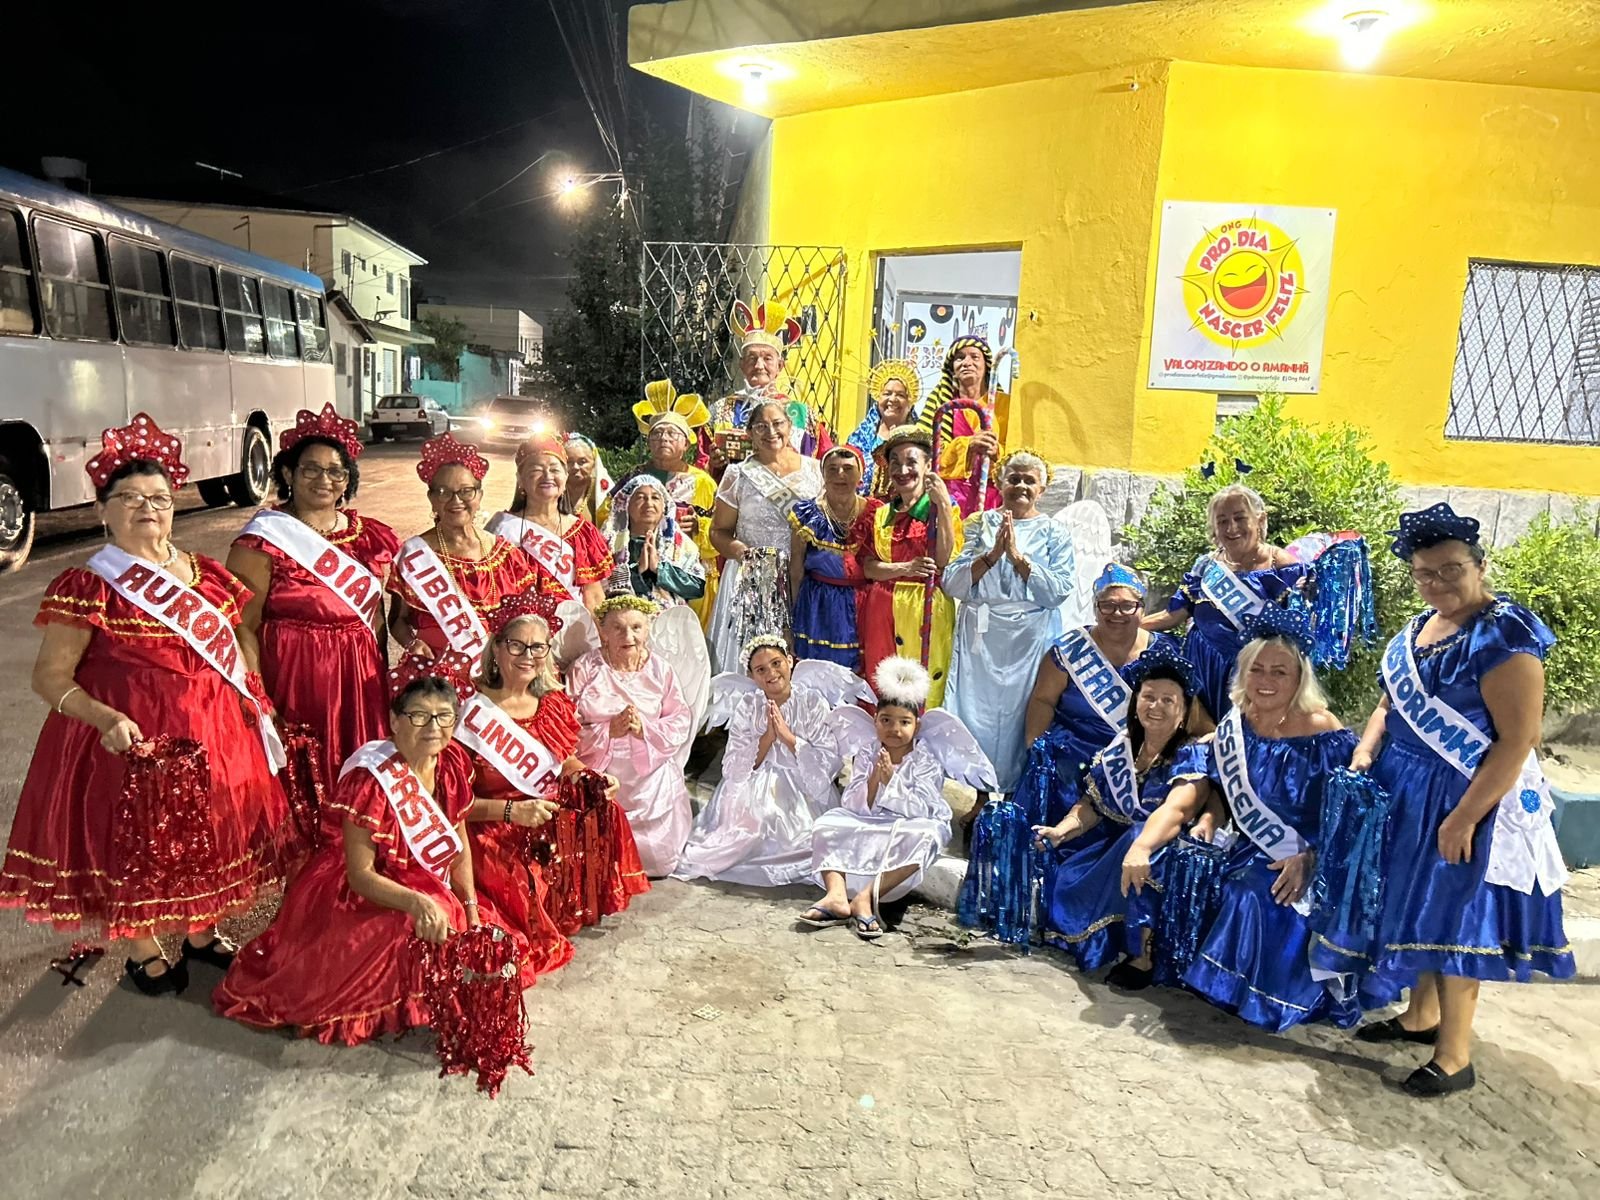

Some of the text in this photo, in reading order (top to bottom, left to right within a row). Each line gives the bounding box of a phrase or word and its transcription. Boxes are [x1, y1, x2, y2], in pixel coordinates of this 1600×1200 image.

[1220, 220, 1242, 233] ONG
[1199, 273, 1294, 338] NASCER FELIZ
[1164, 359, 1309, 373] VALORIZANDO O AMANHÃ
[522, 528, 574, 574] MES
[114, 563, 237, 679] AURORA
[464, 705, 539, 779] LINDA
